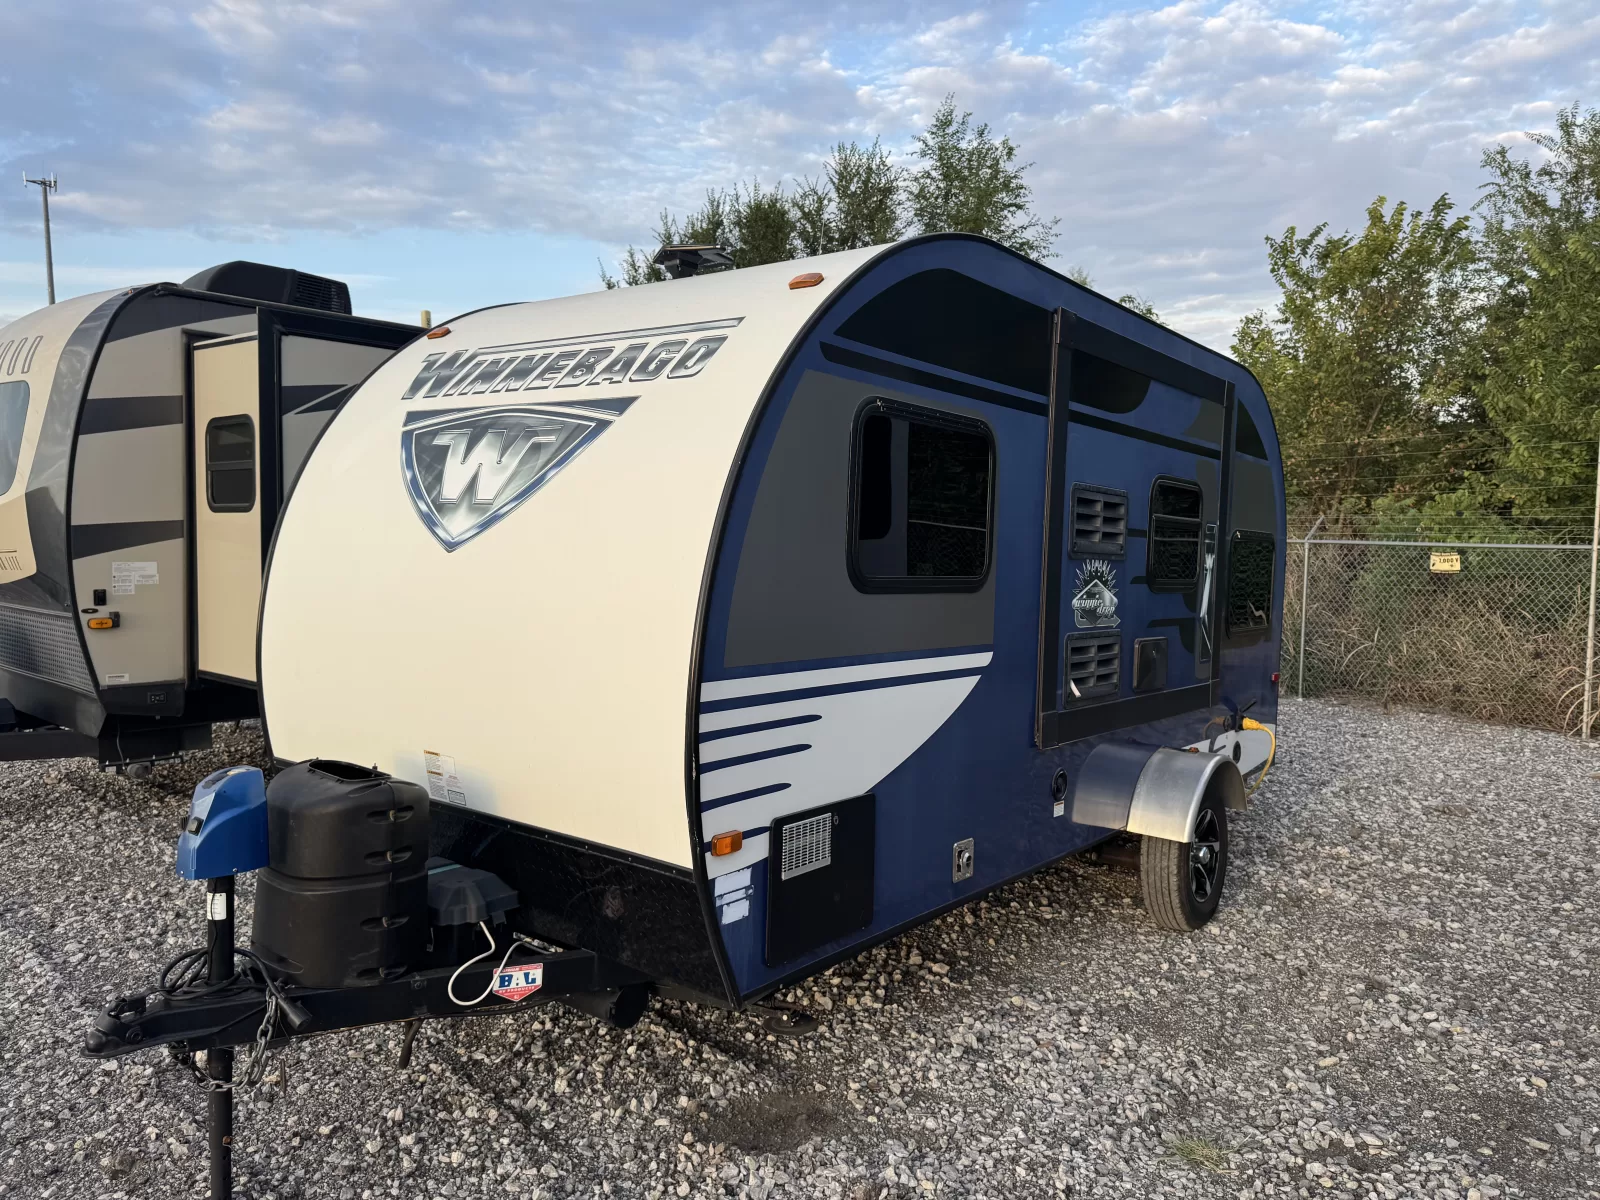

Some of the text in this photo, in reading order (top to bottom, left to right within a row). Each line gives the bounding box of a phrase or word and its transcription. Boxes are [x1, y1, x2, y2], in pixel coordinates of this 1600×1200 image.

[400, 334, 729, 400] WINNEBAGO
[432, 424, 564, 505] W
[498, 971, 537, 989] BAL
